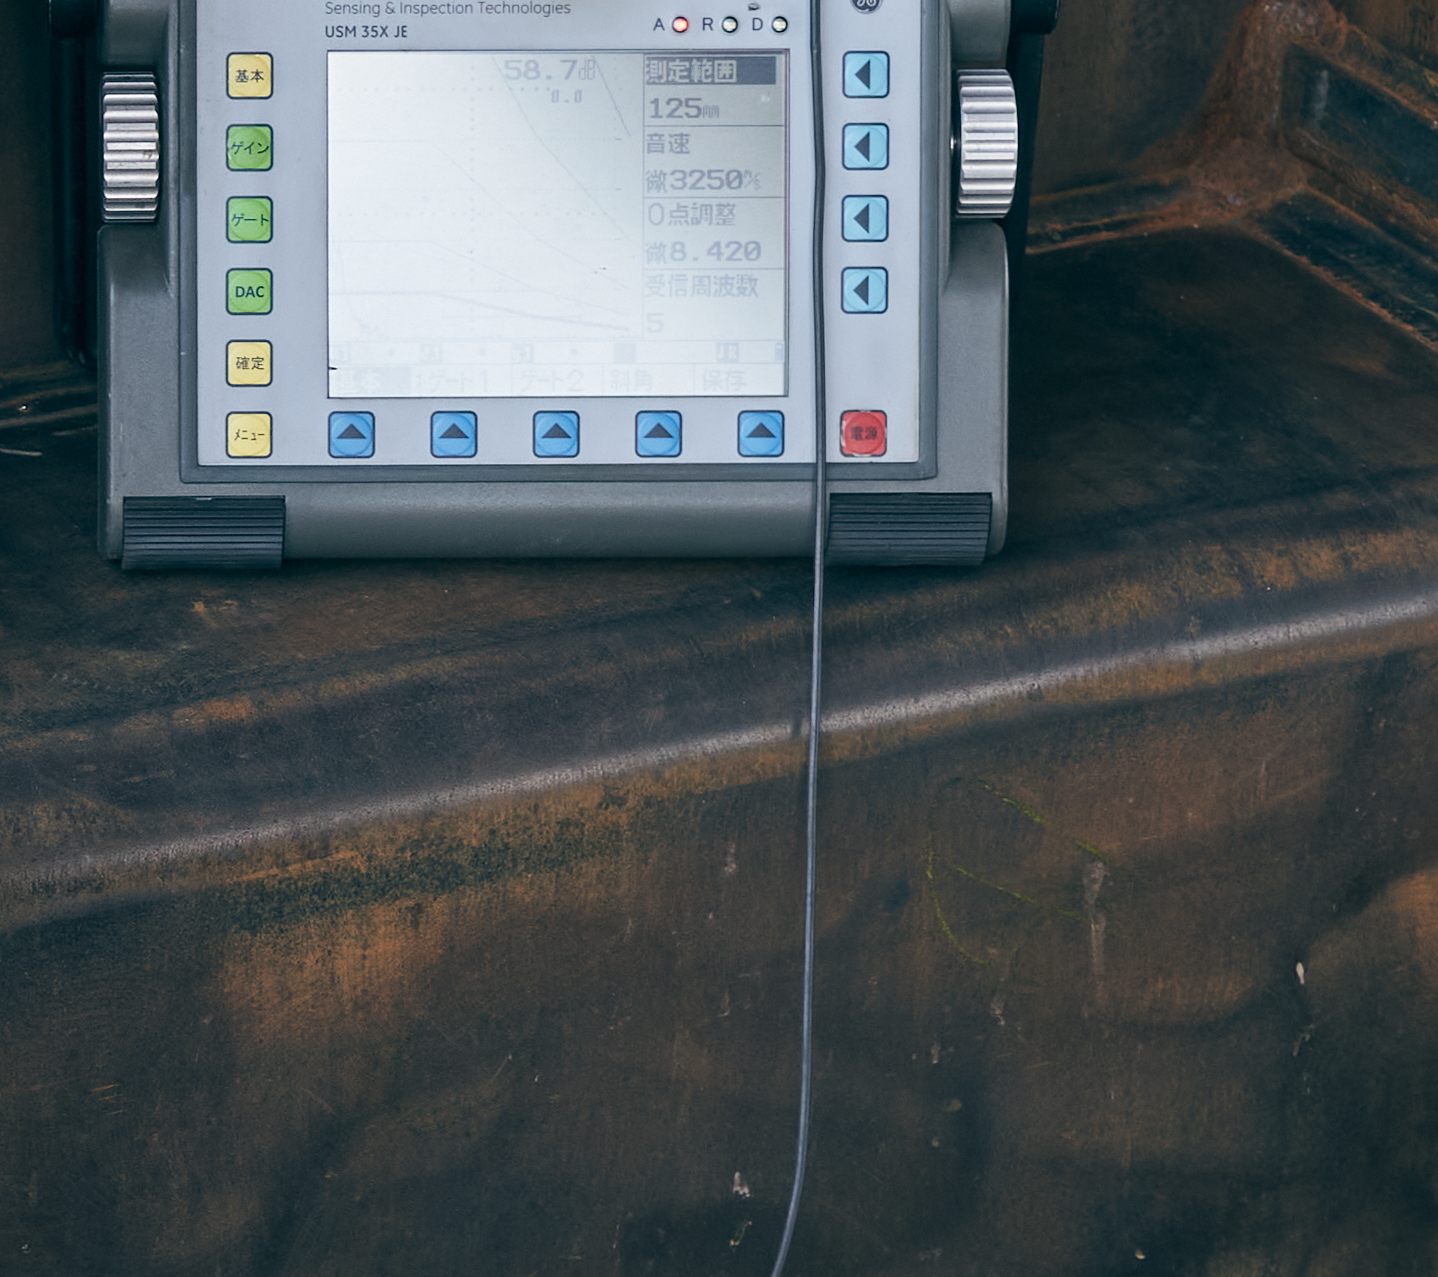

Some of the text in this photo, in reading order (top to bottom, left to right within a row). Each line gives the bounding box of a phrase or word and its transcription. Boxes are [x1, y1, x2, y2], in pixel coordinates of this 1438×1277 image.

[325, 0, 572, 18] Sensing & Inspection Technologies
[325, 25, 358, 39] USM
[361, 25, 389, 39] 35X
[653, 18, 764, 32] A R D
[235, 69, 265, 83] 基本
[645, 58, 738, 84] 測定範囲
[230, 140, 270, 155] ゲイン
[645, 132, 692, 155] 音速
[231, 213, 270, 227] ゲート
[235, 285, 266, 299] DAC
[644, 273, 760, 298] 受信周波数
[235, 355, 266, 371] 確定
[234, 428, 266, 442] メニュー
